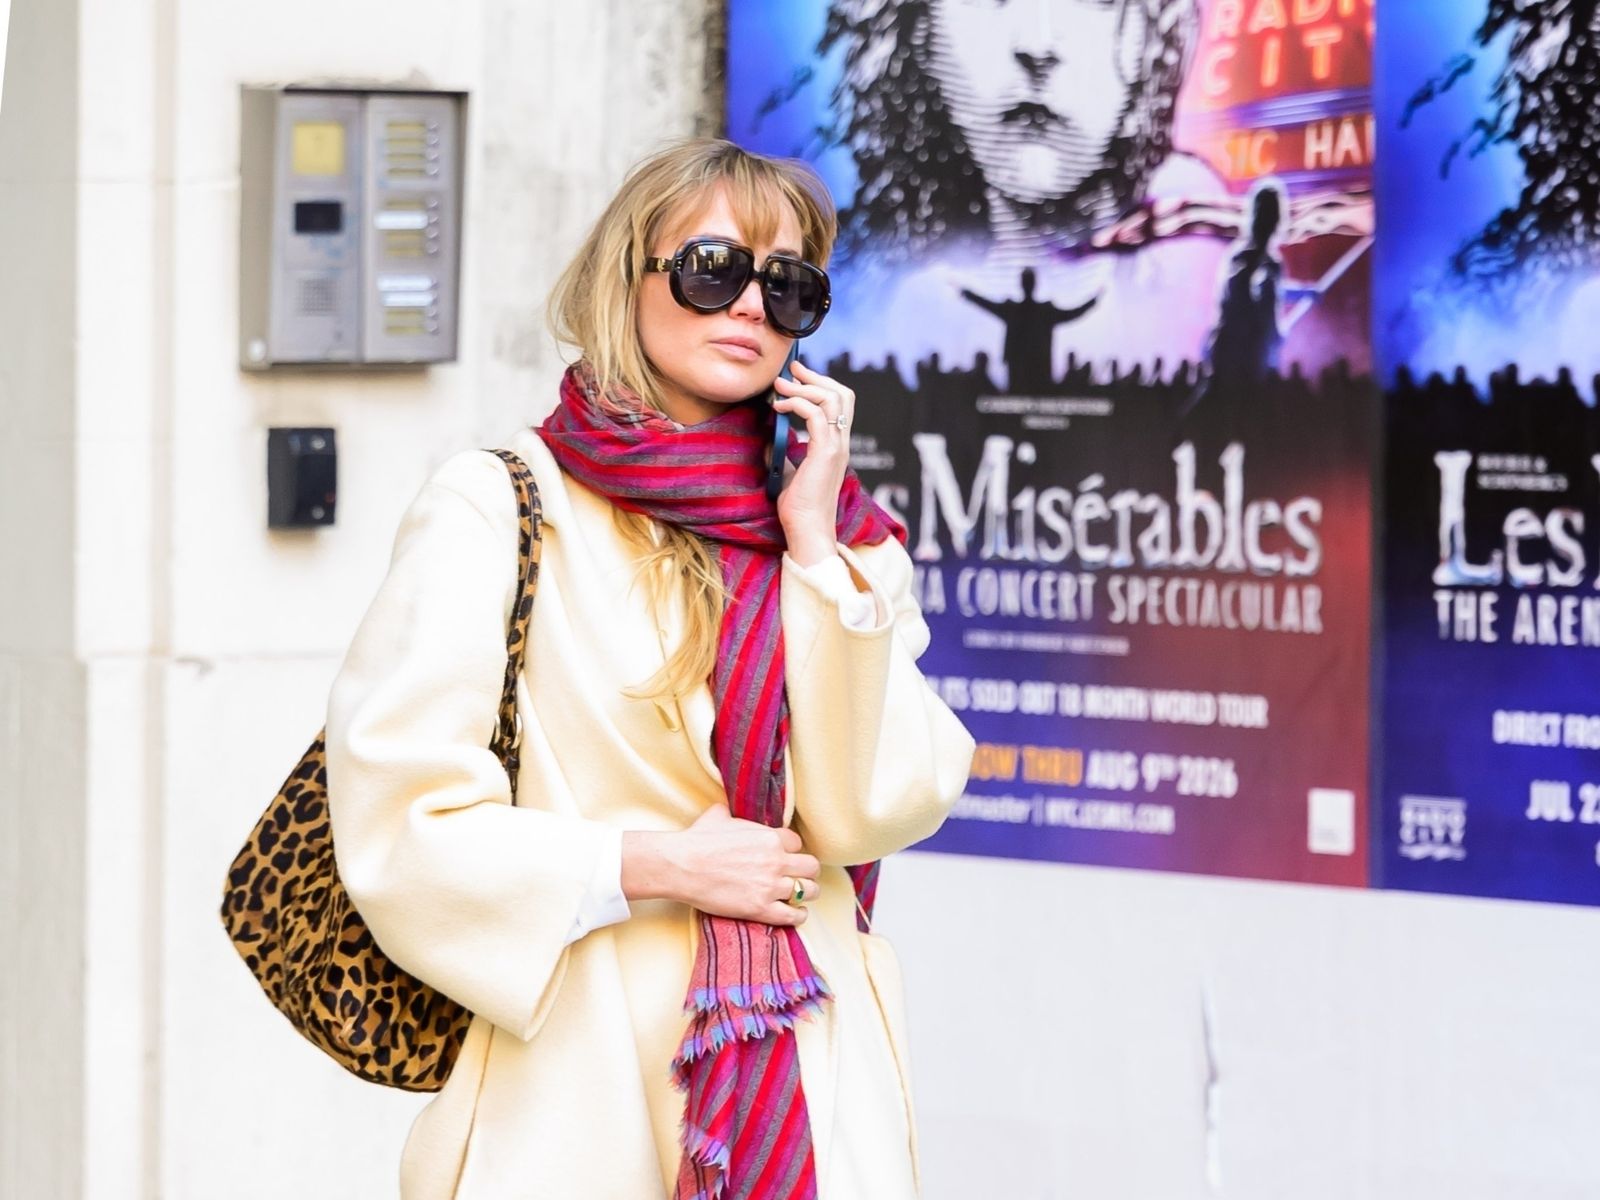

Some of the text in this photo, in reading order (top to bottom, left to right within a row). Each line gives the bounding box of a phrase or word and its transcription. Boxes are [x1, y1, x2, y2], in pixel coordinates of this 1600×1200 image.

[1203, 24, 1375, 96] CIT
[912, 432, 1322, 576] Misérables
[1432, 449, 1587, 588] Les
[957, 566, 1097, 622] CONCERT
[1107, 574, 1323, 634] SPECTACULAR
[1433, 588, 1499, 643] THE
[970, 678, 1018, 714] SOLD
[1018, 680, 1057, 716] OUT
[1083, 684, 1149, 722] MONTH
[1151, 688, 1218, 726] WORLD
[1217, 692, 1269, 730] TOUR
[1493, 710, 1562, 747] DIRECT
[1023, 745, 1084, 788] THRU
[1085, 749, 1140, 792] AUG
[1176, 755, 1239, 799] 2026
[1526, 780, 1600, 825] JUL 2
